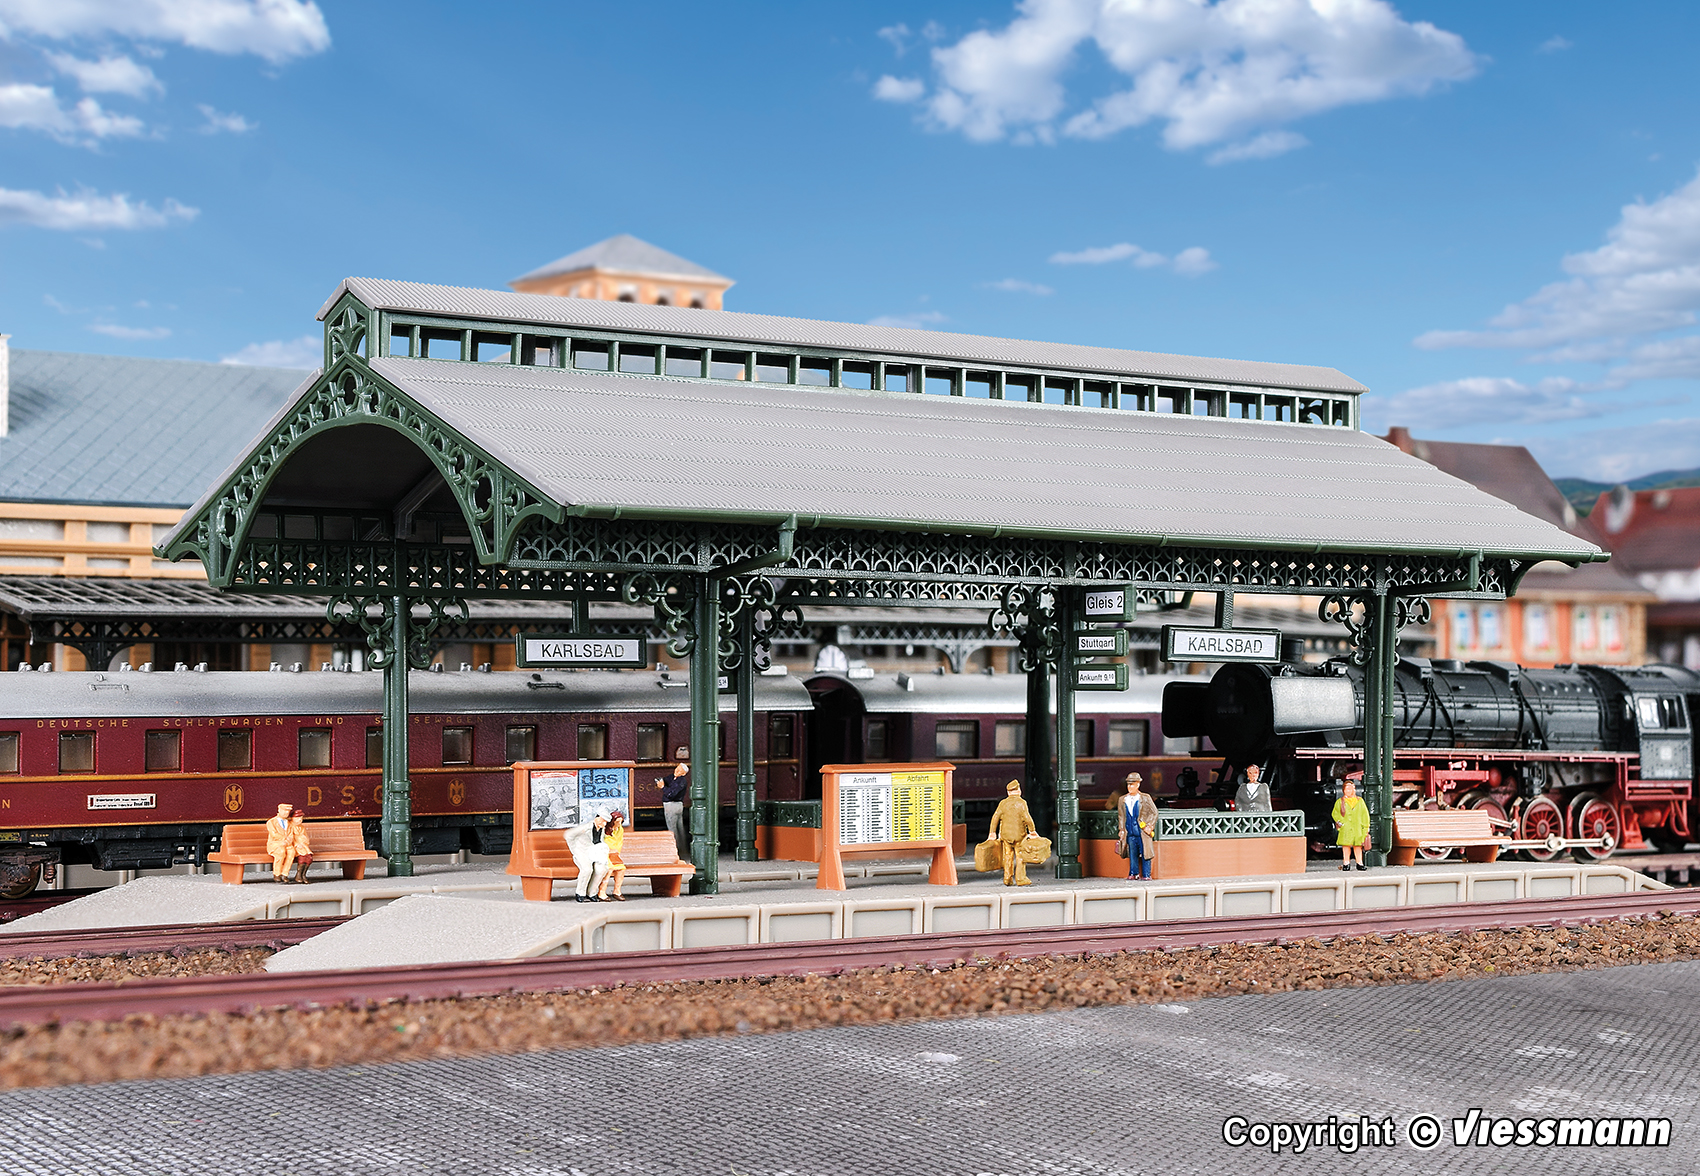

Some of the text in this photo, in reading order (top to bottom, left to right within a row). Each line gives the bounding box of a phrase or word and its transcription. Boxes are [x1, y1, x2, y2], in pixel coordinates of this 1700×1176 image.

[1087, 595, 1123, 609] Gleis 2
[1080, 638, 1114, 648] Stuttgart
[1187, 637, 1263, 654] KARLSBAD
[541, 643, 625, 658] KARLSBAD
[37, 718, 129, 729] DEUTSCHE
[163, 717, 284, 727] SCHLAFWAGEN
[315, 716, 344, 726] UND
[374, 716, 483, 724] SSEWAGEN
[581, 769, 618, 784] das
